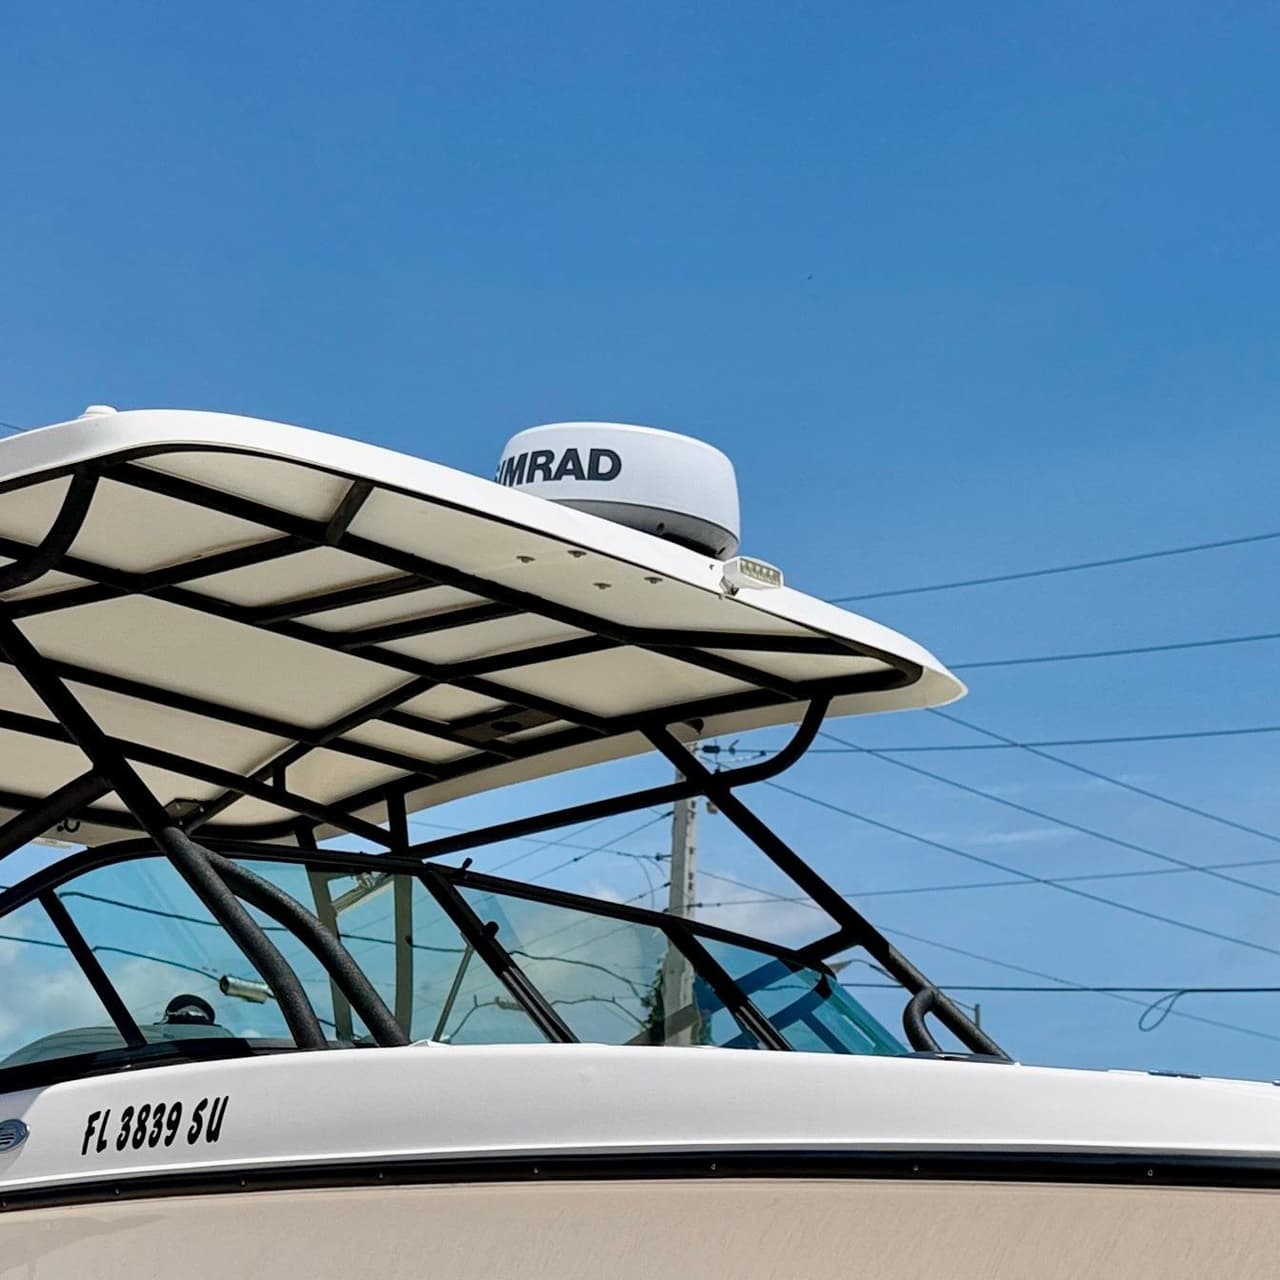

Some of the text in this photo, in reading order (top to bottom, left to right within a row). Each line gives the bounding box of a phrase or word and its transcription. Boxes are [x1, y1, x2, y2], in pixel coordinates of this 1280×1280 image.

[81, 1096, 229, 1155] FL 3839 SU
